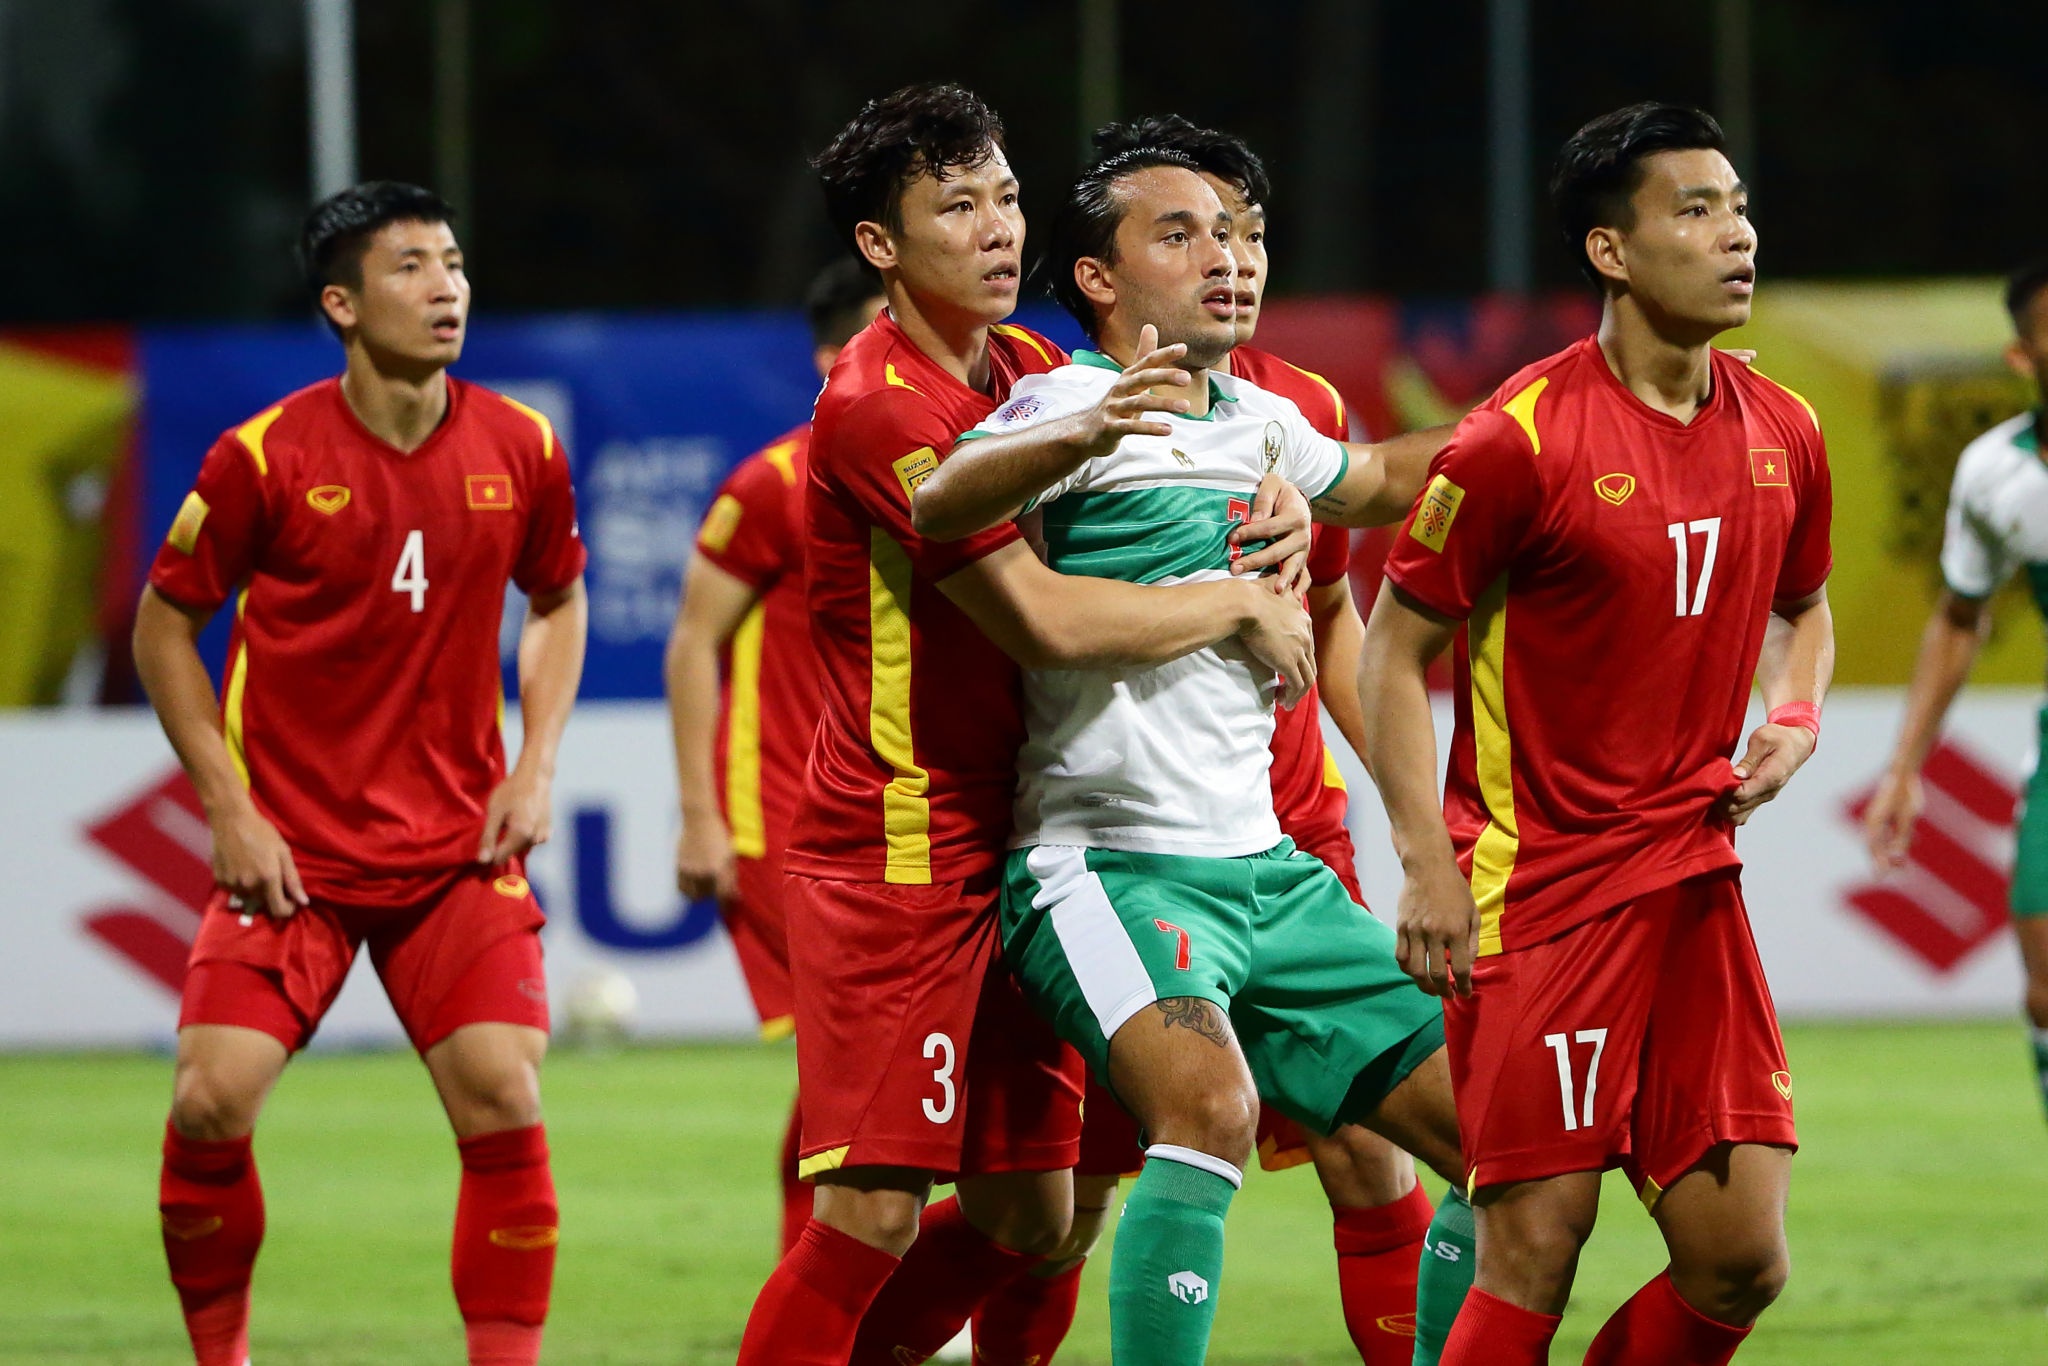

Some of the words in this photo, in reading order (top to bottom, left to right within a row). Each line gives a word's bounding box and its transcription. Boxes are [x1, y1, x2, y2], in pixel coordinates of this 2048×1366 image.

[903, 456, 931, 473] SUZUKI
[391, 529, 430, 613] 4
[1667, 517, 1722, 617] 17
[1153, 917, 1191, 971] 7
[922, 1032, 956, 1124] 3
[1544, 1027, 1608, 1131] 17
